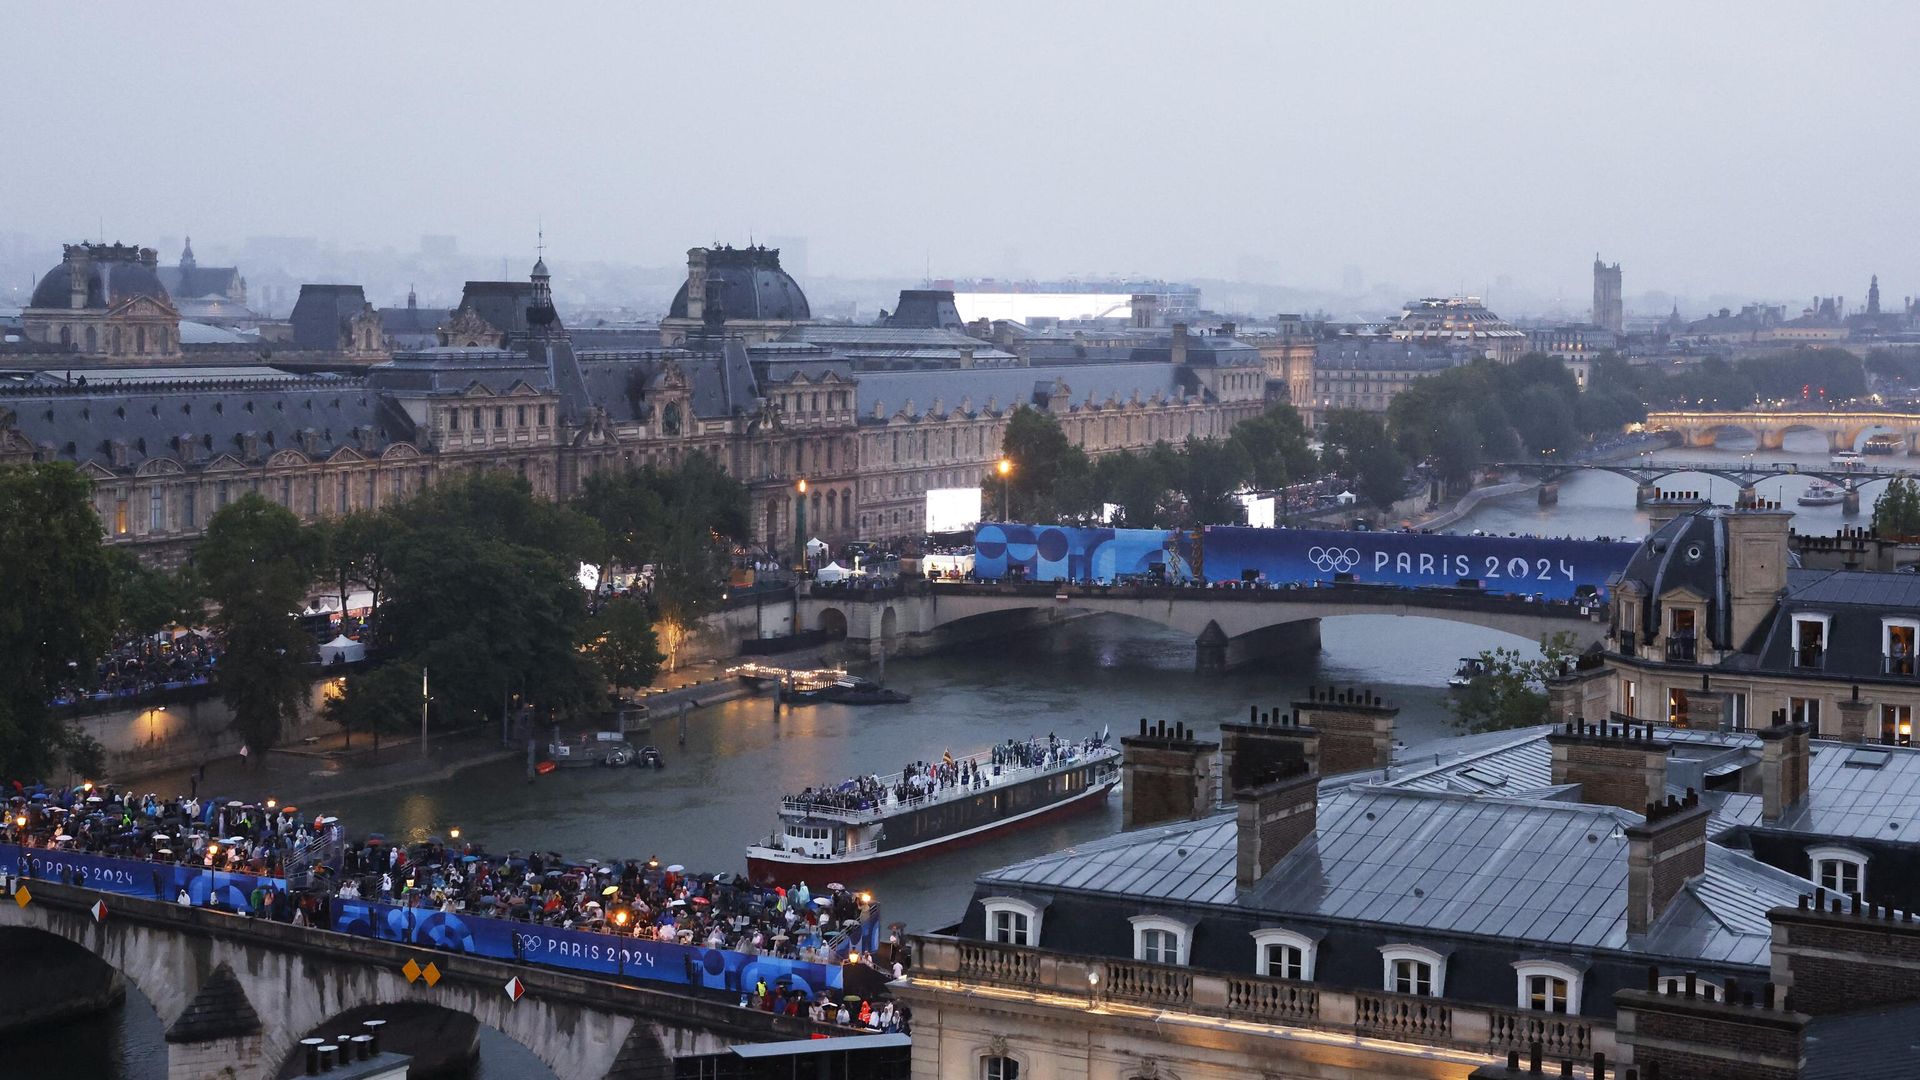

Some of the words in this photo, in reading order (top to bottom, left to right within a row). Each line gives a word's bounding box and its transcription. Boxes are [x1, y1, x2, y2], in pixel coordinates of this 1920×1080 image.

[1485, 556, 1574, 581] 2024
[94, 867, 133, 885] 2024
[607, 947, 655, 967] 2024
